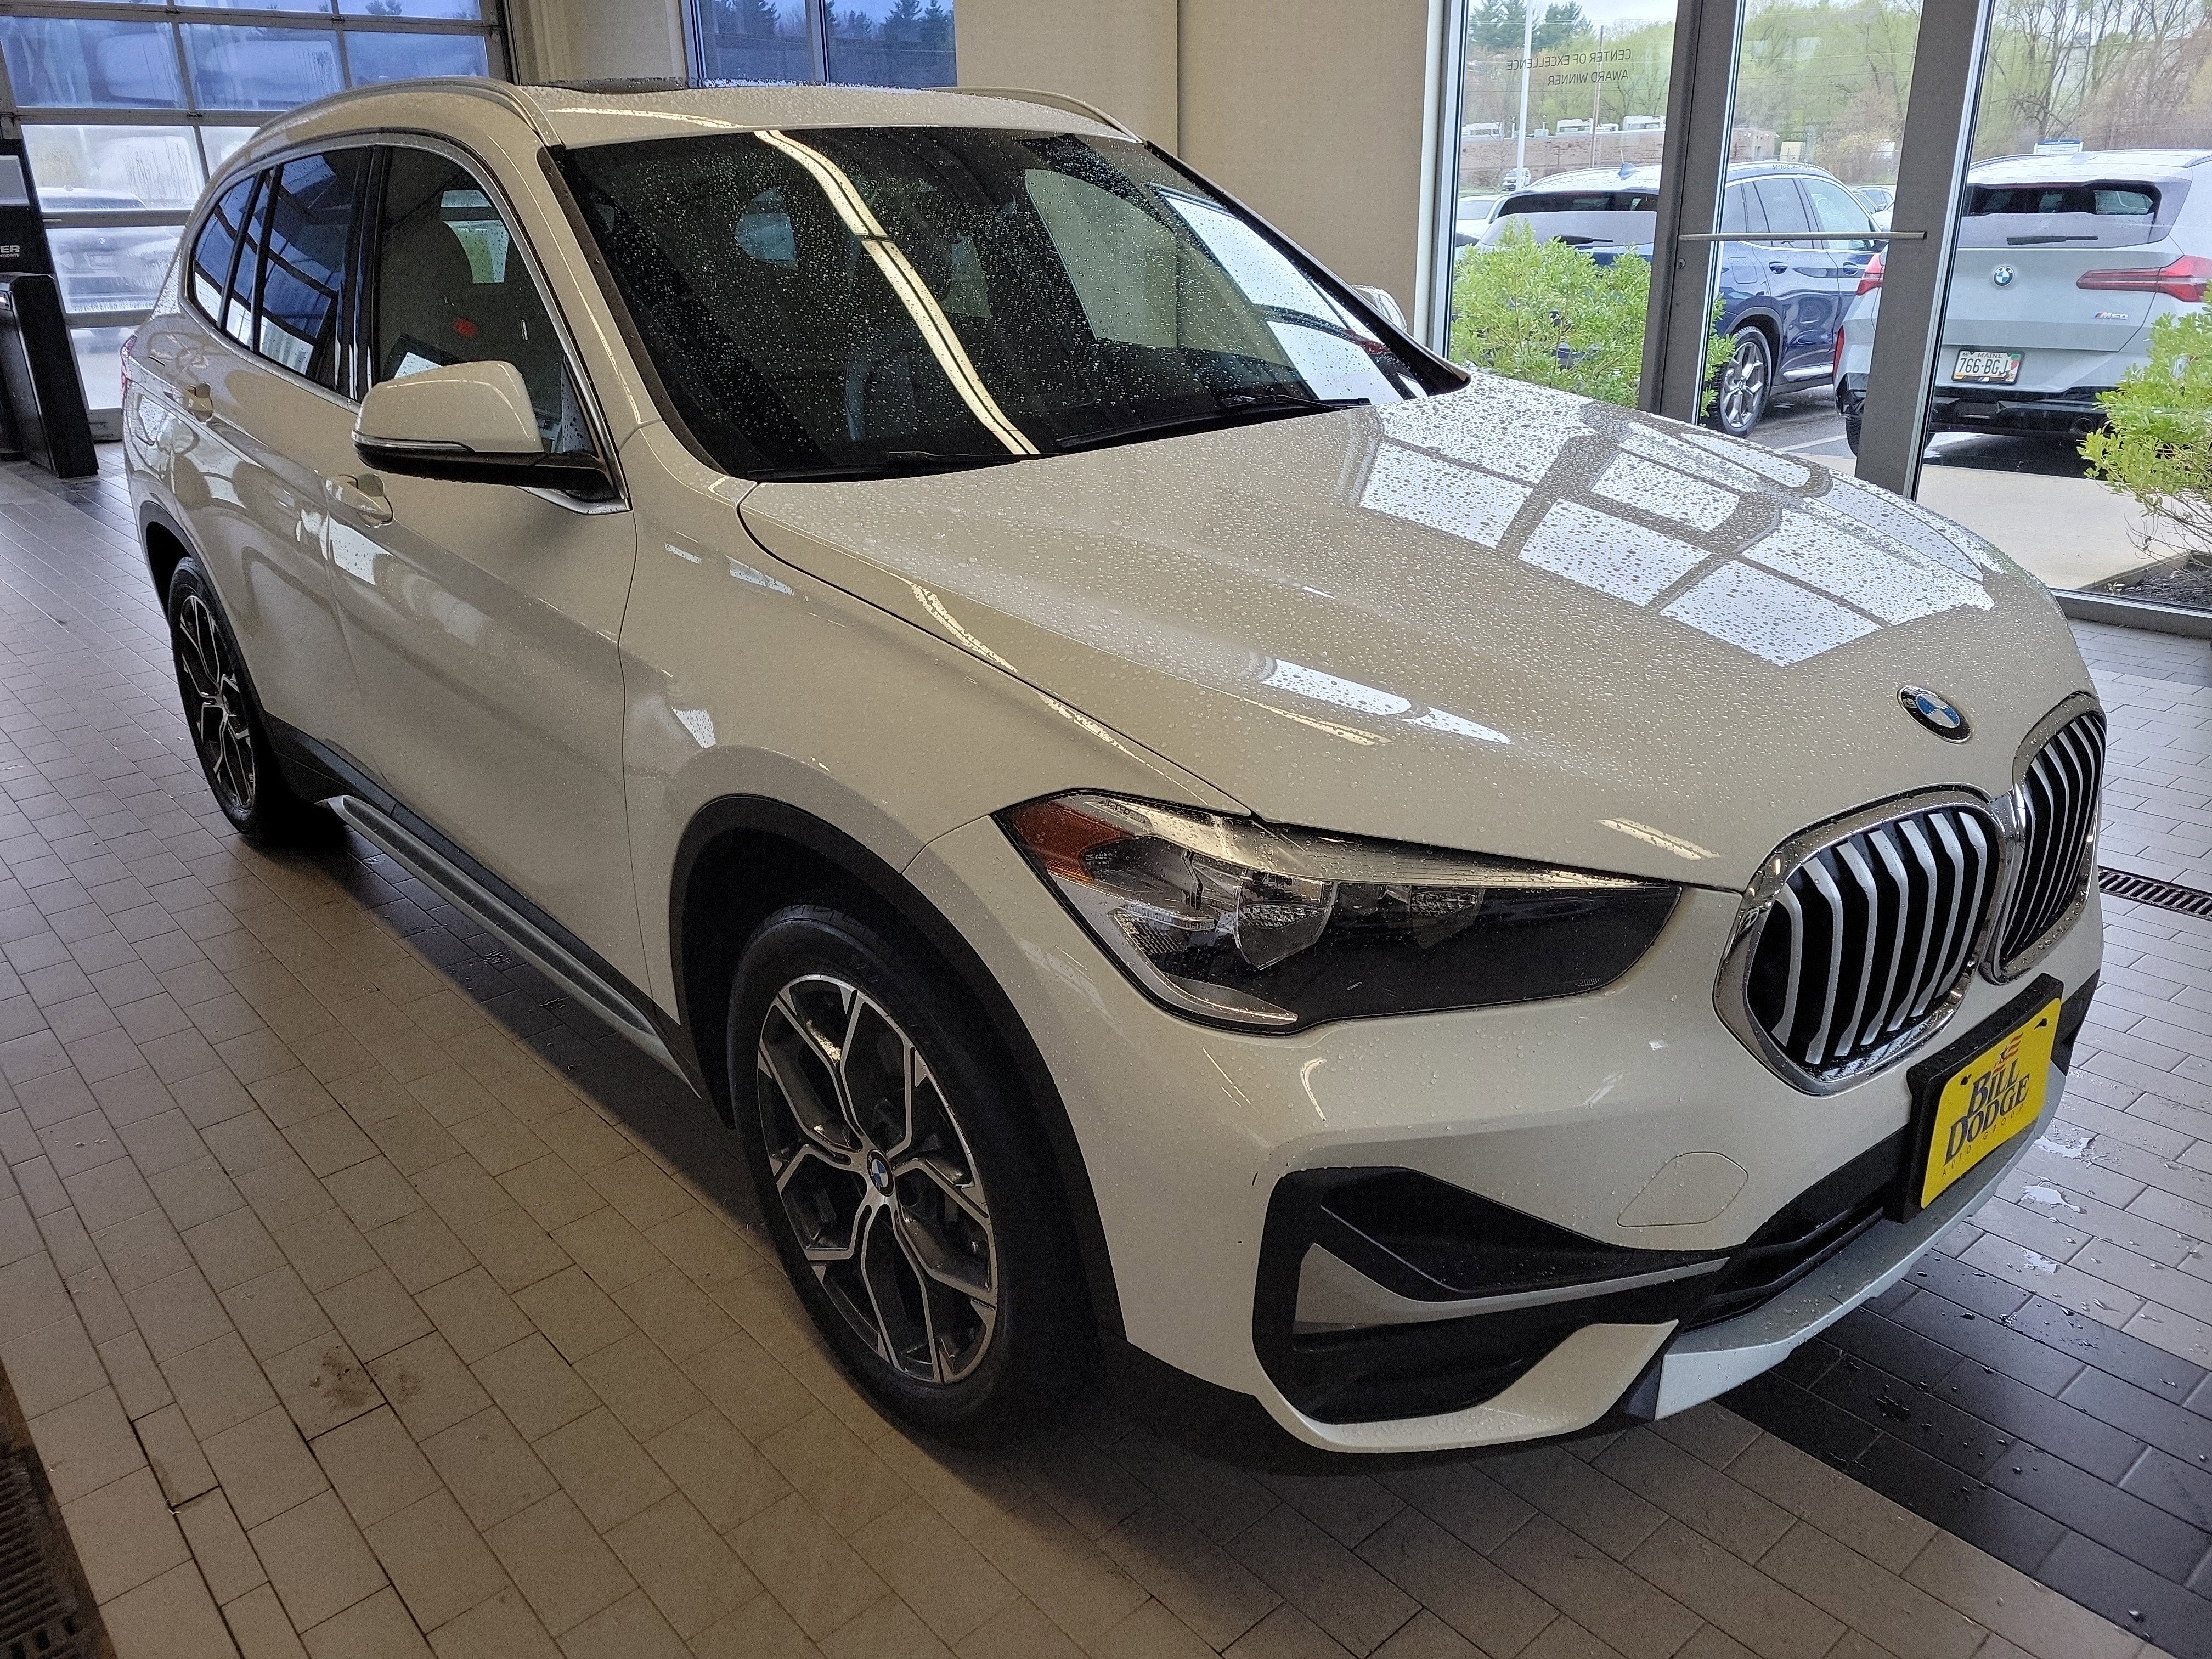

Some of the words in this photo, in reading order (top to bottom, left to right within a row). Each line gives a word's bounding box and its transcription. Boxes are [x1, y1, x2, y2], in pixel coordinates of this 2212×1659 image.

[1943, 1072, 2030, 1167] DODGE
[1967, 1058, 2021, 1119] BILL
[1941, 1144, 1972, 1178] AUTO
[1983, 1103, 2024, 1141] GROUP
